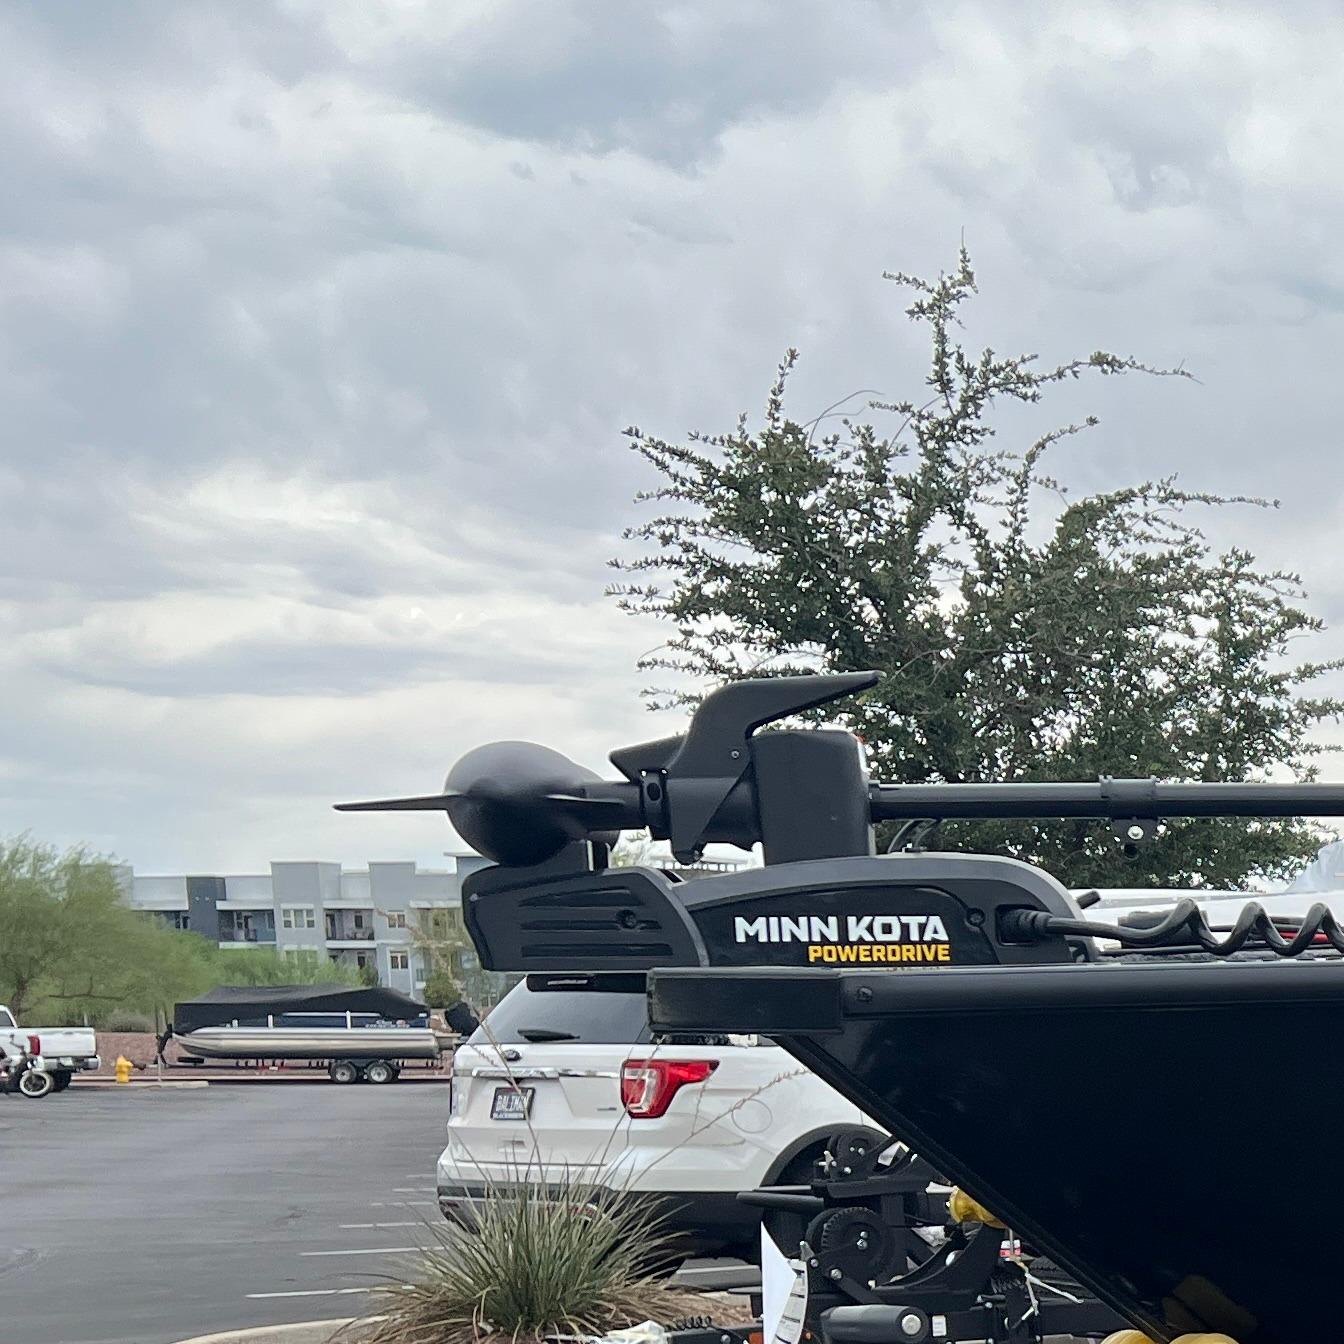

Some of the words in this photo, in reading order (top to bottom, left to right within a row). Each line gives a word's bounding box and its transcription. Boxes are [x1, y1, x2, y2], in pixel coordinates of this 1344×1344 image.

[734, 915, 838, 943] MINN
[846, 915, 949, 942] KOTA
[808, 943, 951, 962] POWERDRIVE
